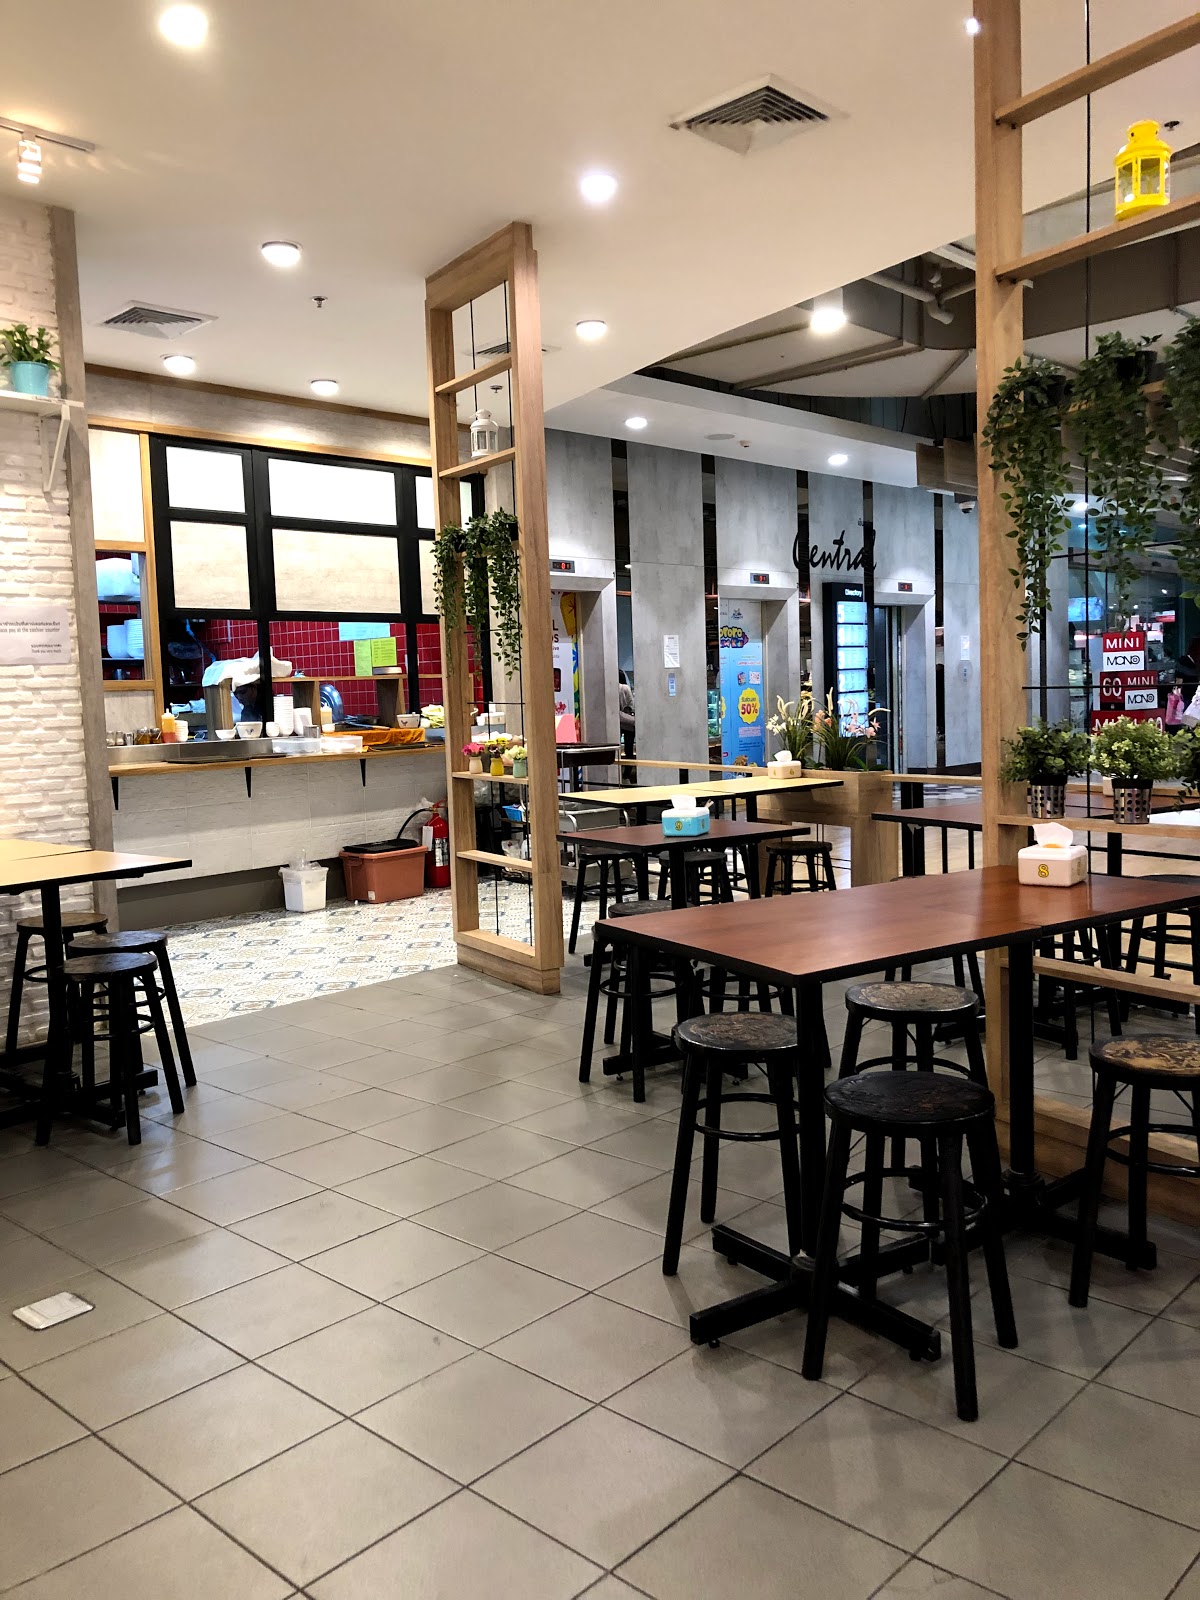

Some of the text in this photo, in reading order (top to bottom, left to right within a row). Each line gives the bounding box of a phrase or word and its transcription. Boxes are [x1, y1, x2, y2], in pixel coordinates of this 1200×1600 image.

[1106, 638, 1139, 649] MINI
[1107, 655, 1140, 666] MONO
[1127, 676, 1154, 686] MINI
[1127, 694, 1155, 704] MONO
[741, 702, 758, 715] 50%
[1037, 863, 1050, 878] 8
